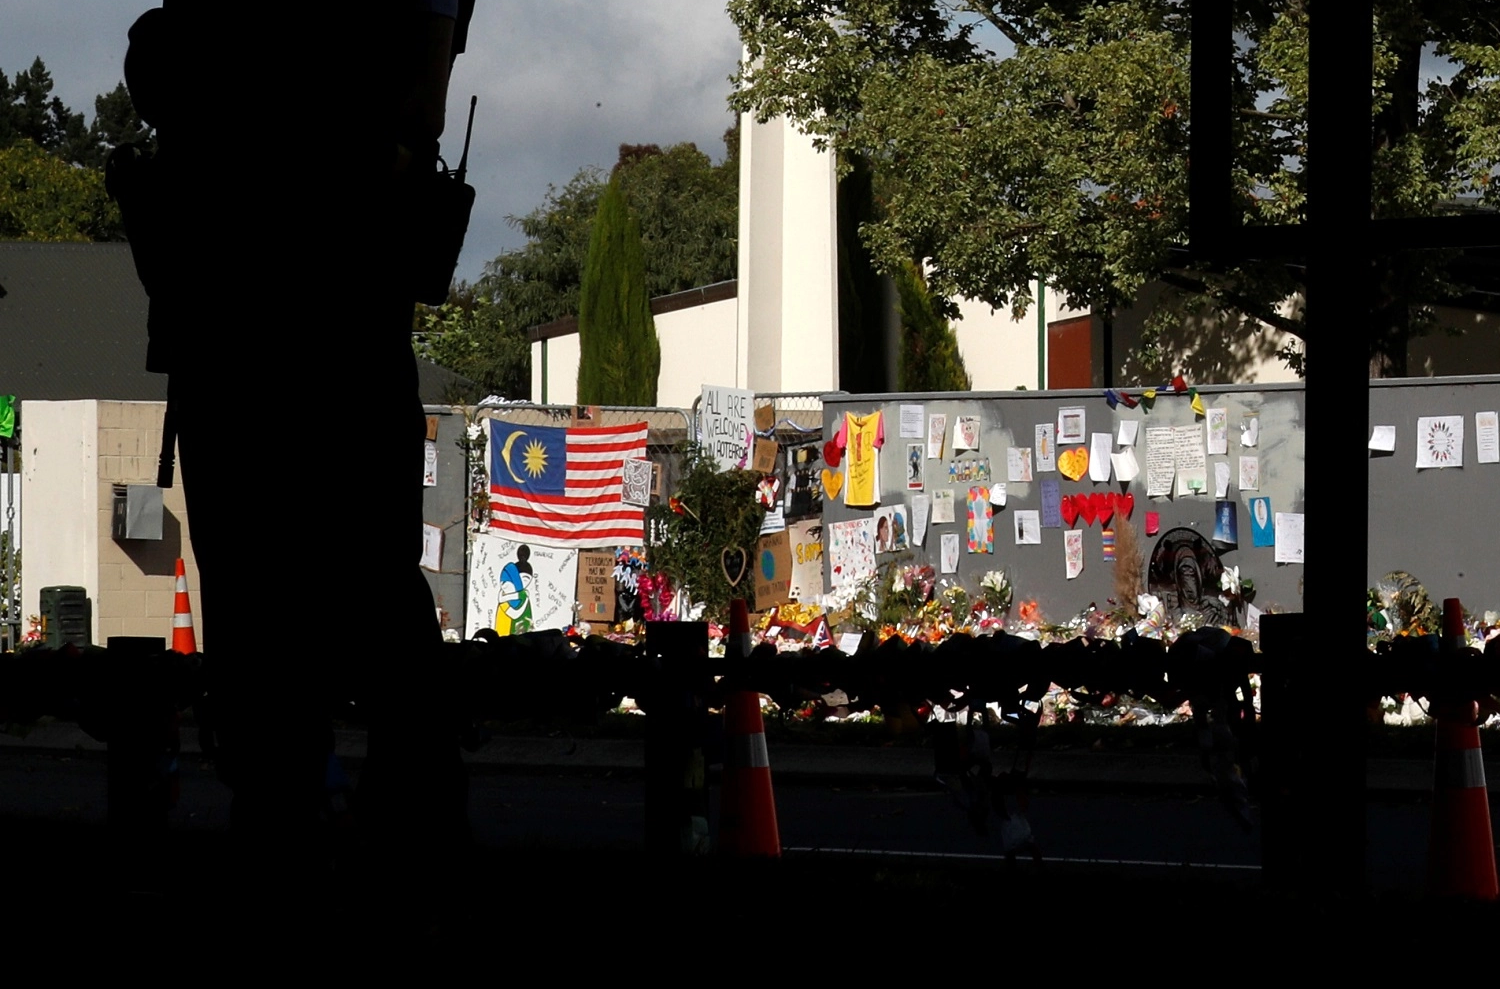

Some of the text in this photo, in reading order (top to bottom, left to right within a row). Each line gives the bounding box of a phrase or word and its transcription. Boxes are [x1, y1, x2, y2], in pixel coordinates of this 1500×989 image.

[706, 390, 746, 419] ALL ARE
[705, 416, 745, 441] WELCOME
[585, 556, 613, 566] TERRORISM
[599, 567, 606, 576] NO
[585, 576, 608, 585] RELIGION
[591, 585, 604, 594] RACE
